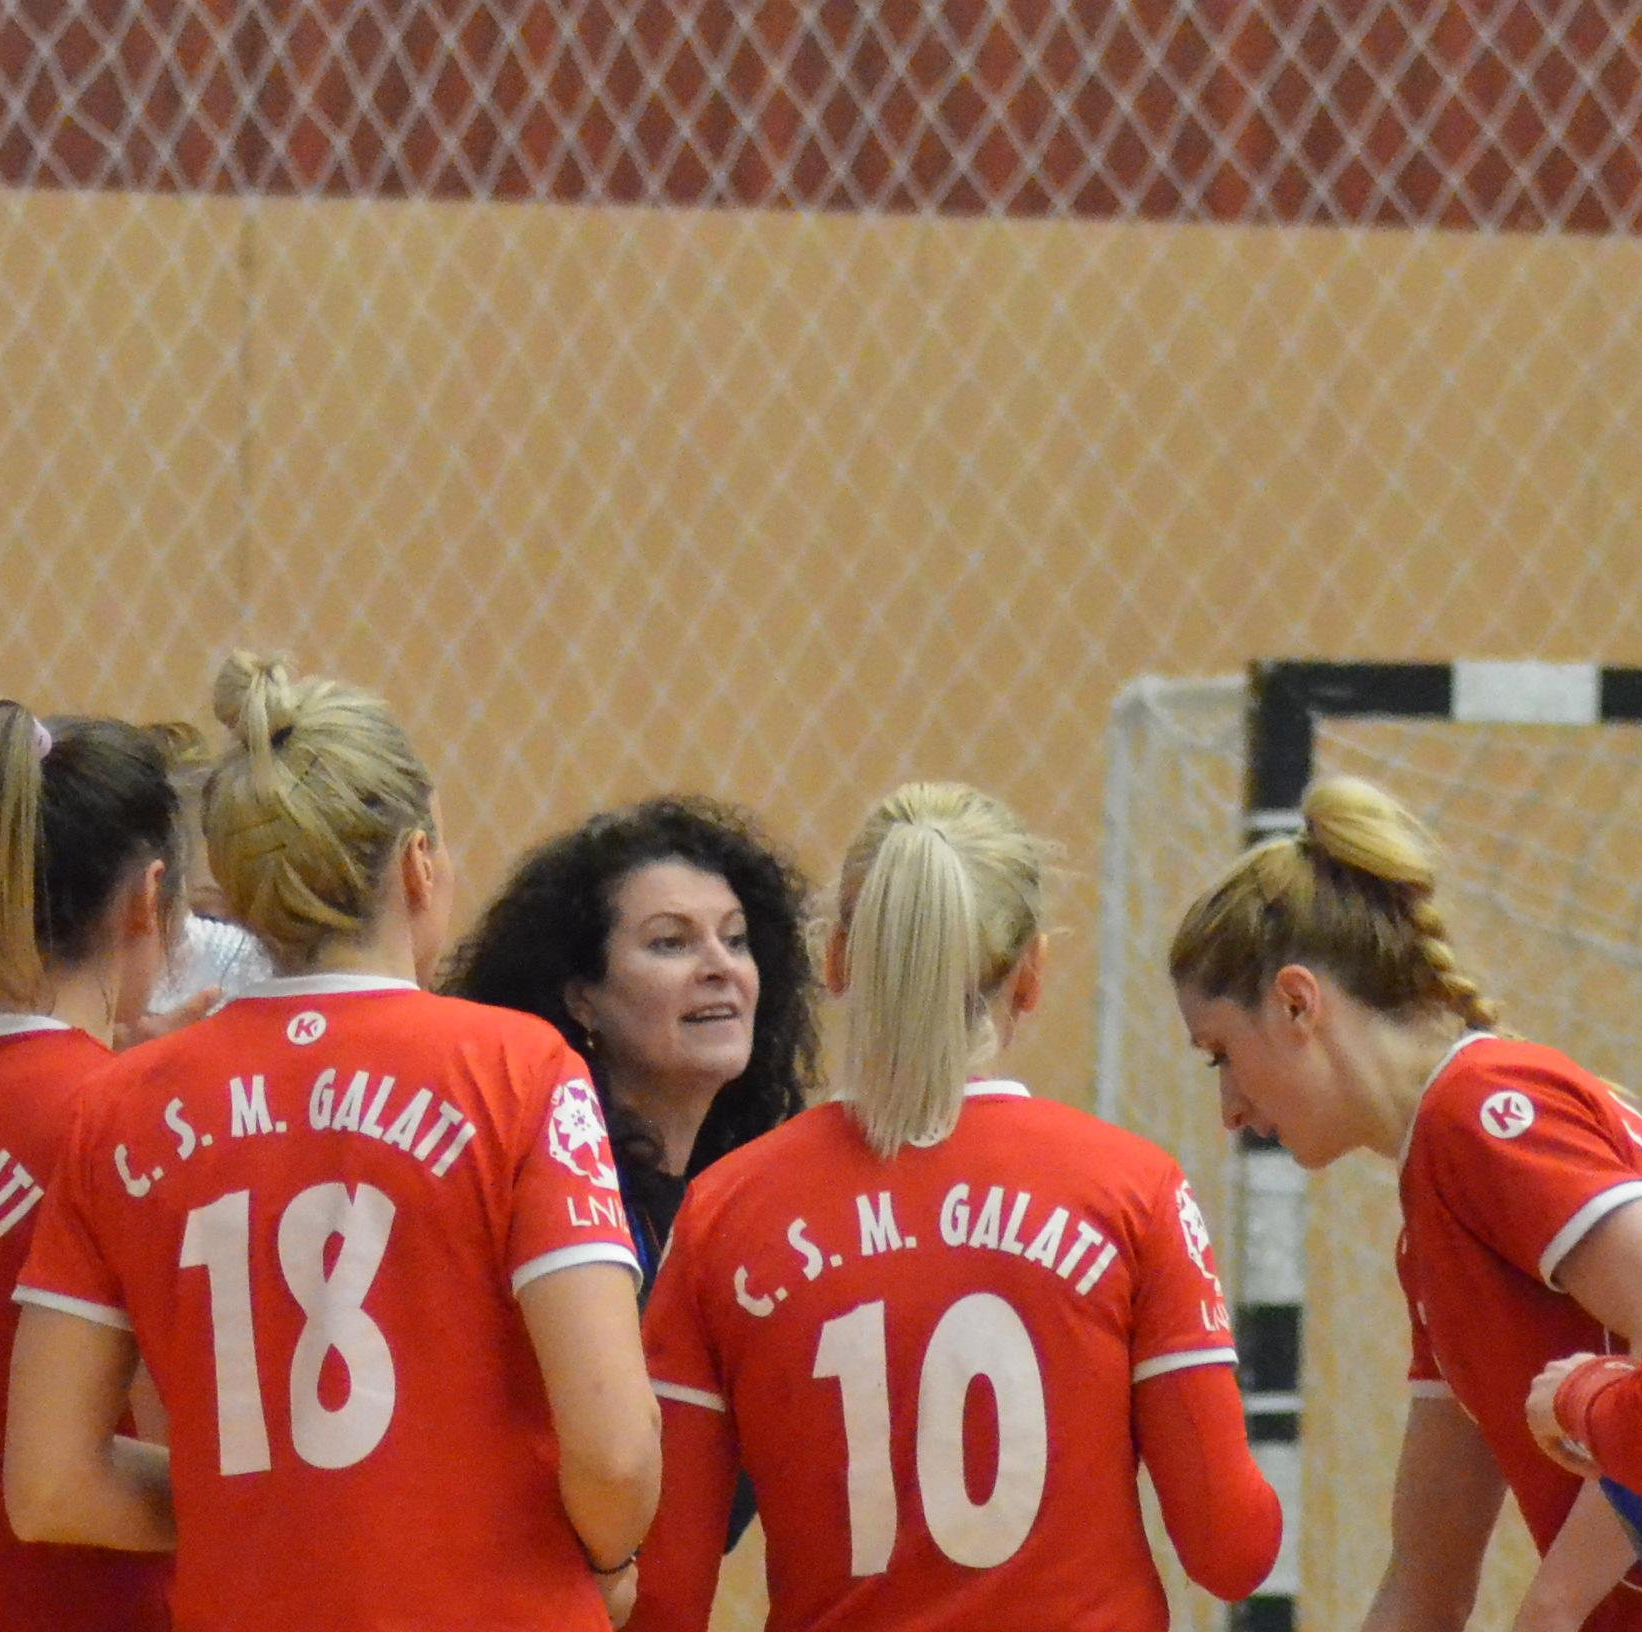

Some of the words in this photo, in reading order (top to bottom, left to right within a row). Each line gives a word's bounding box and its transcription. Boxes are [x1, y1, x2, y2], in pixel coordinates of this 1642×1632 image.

[113, 1143, 165, 1199] C.
[164, 1096, 215, 1161] S.
[229, 1073, 289, 1138] M.
[308, 1067, 478, 1179] GALATI
[177, 1180, 397, 1477] 18
[733, 1264, 788, 1319] C.
[786, 1216, 844, 1282] S.
[855, 1189, 919, 1258] M.
[937, 1182, 1119, 1297] GALATI
[811, 1291, 1049, 1578] 10
